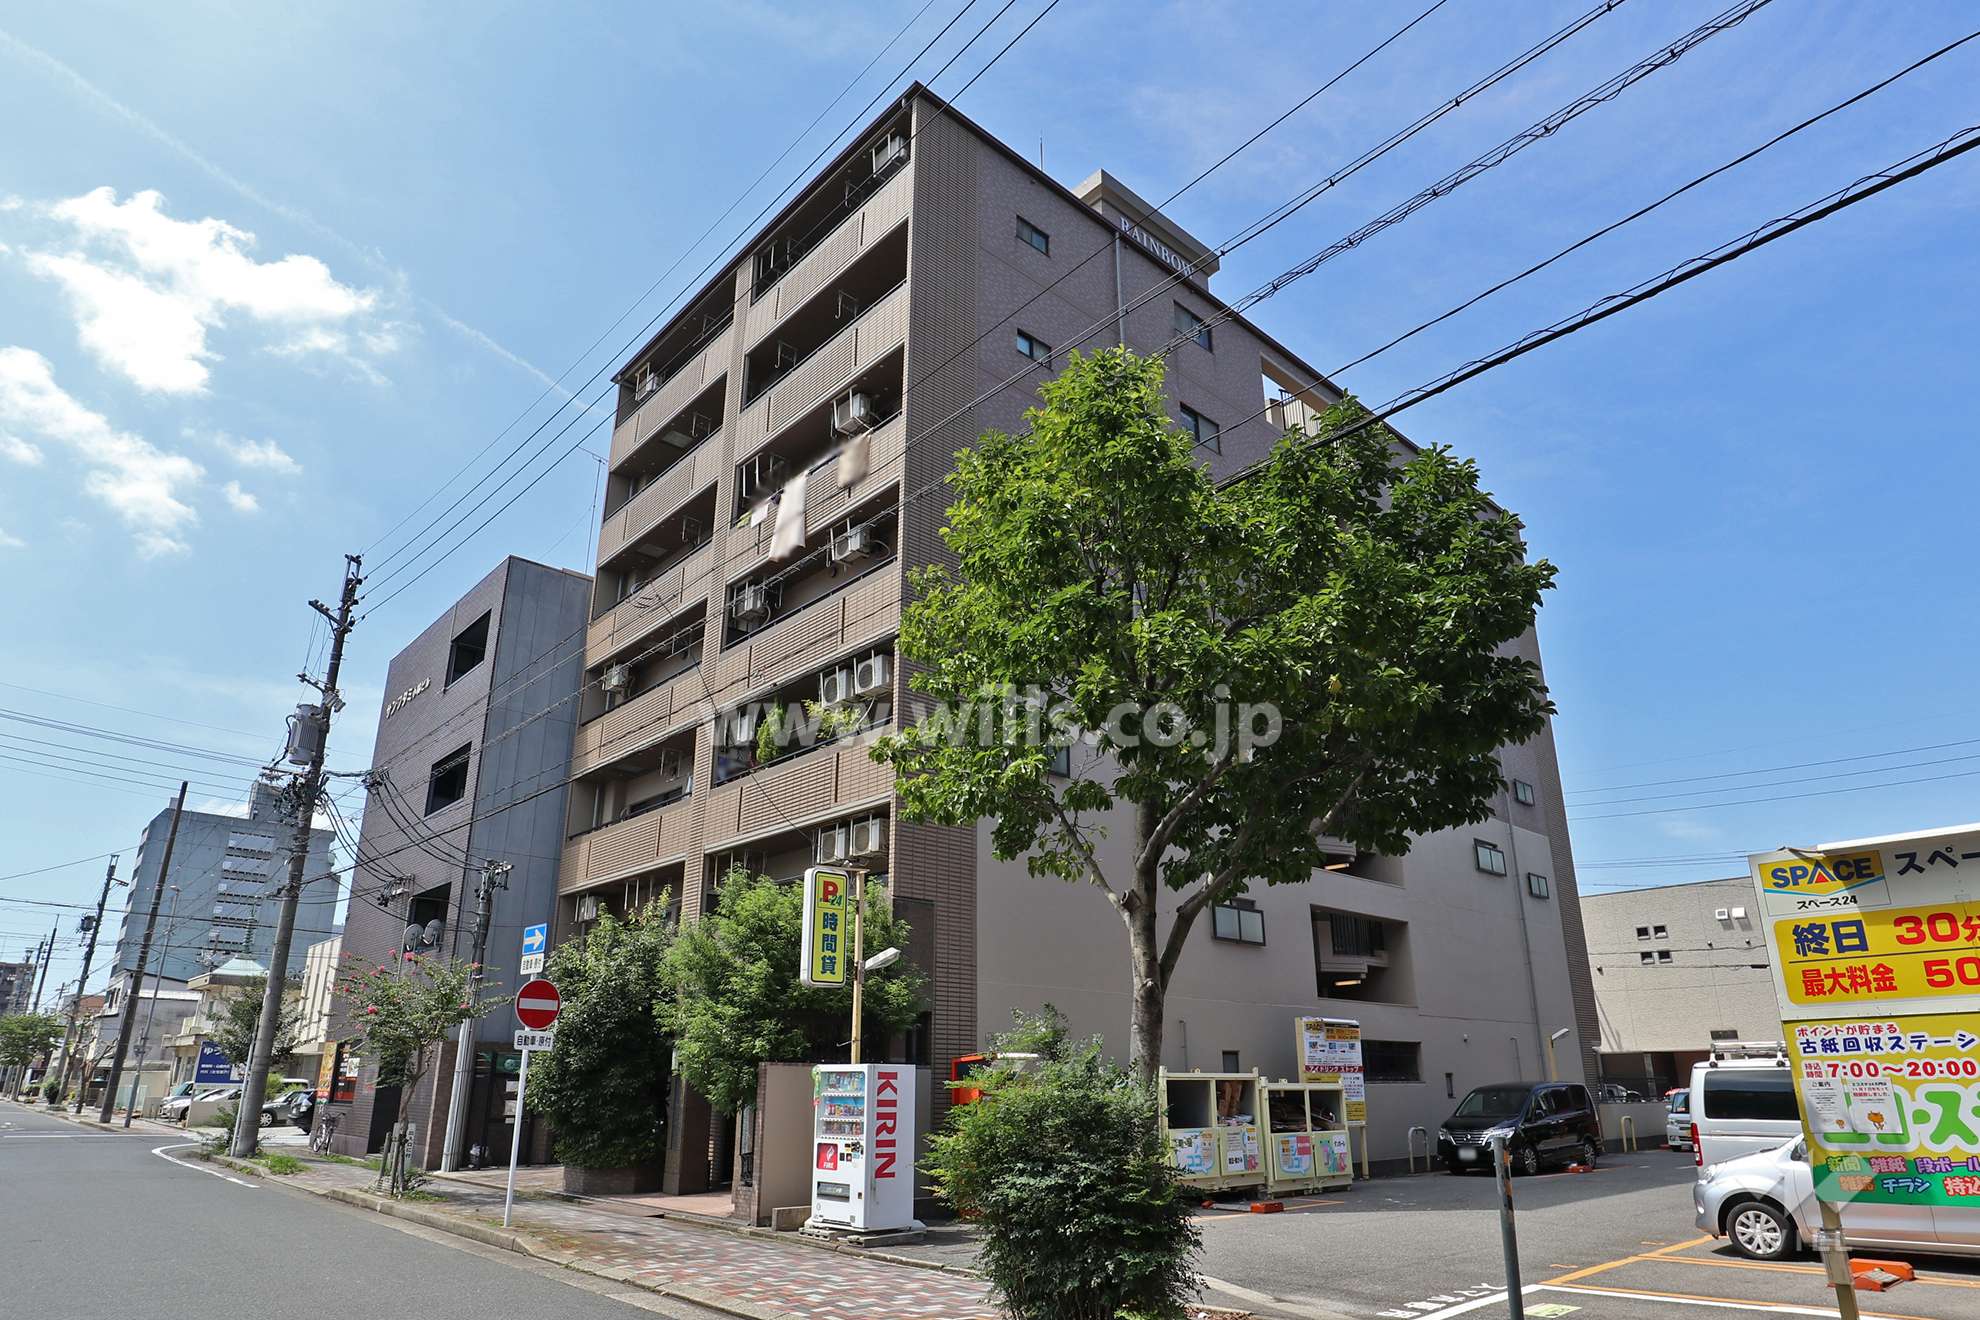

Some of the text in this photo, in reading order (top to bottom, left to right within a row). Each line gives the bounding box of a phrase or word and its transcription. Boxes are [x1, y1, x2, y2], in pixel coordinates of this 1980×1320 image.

[1119, 217, 1194, 279] RAINBOW
[1771, 858, 1874, 888] SPACE
[1796, 895, 1858, 910] スペース24
[821, 912, 838, 975] 時間貸
[1792, 919, 1869, 957] 終日
[1801, 963, 1897, 997] 最大料金
[1797, 1024, 1898, 1037] ポイントが貯まる
[875, 1071, 898, 1179] KIRIN
[1827, 1156, 1862, 1172] 新聞
[1882, 1178, 1931, 1193] チラシ
